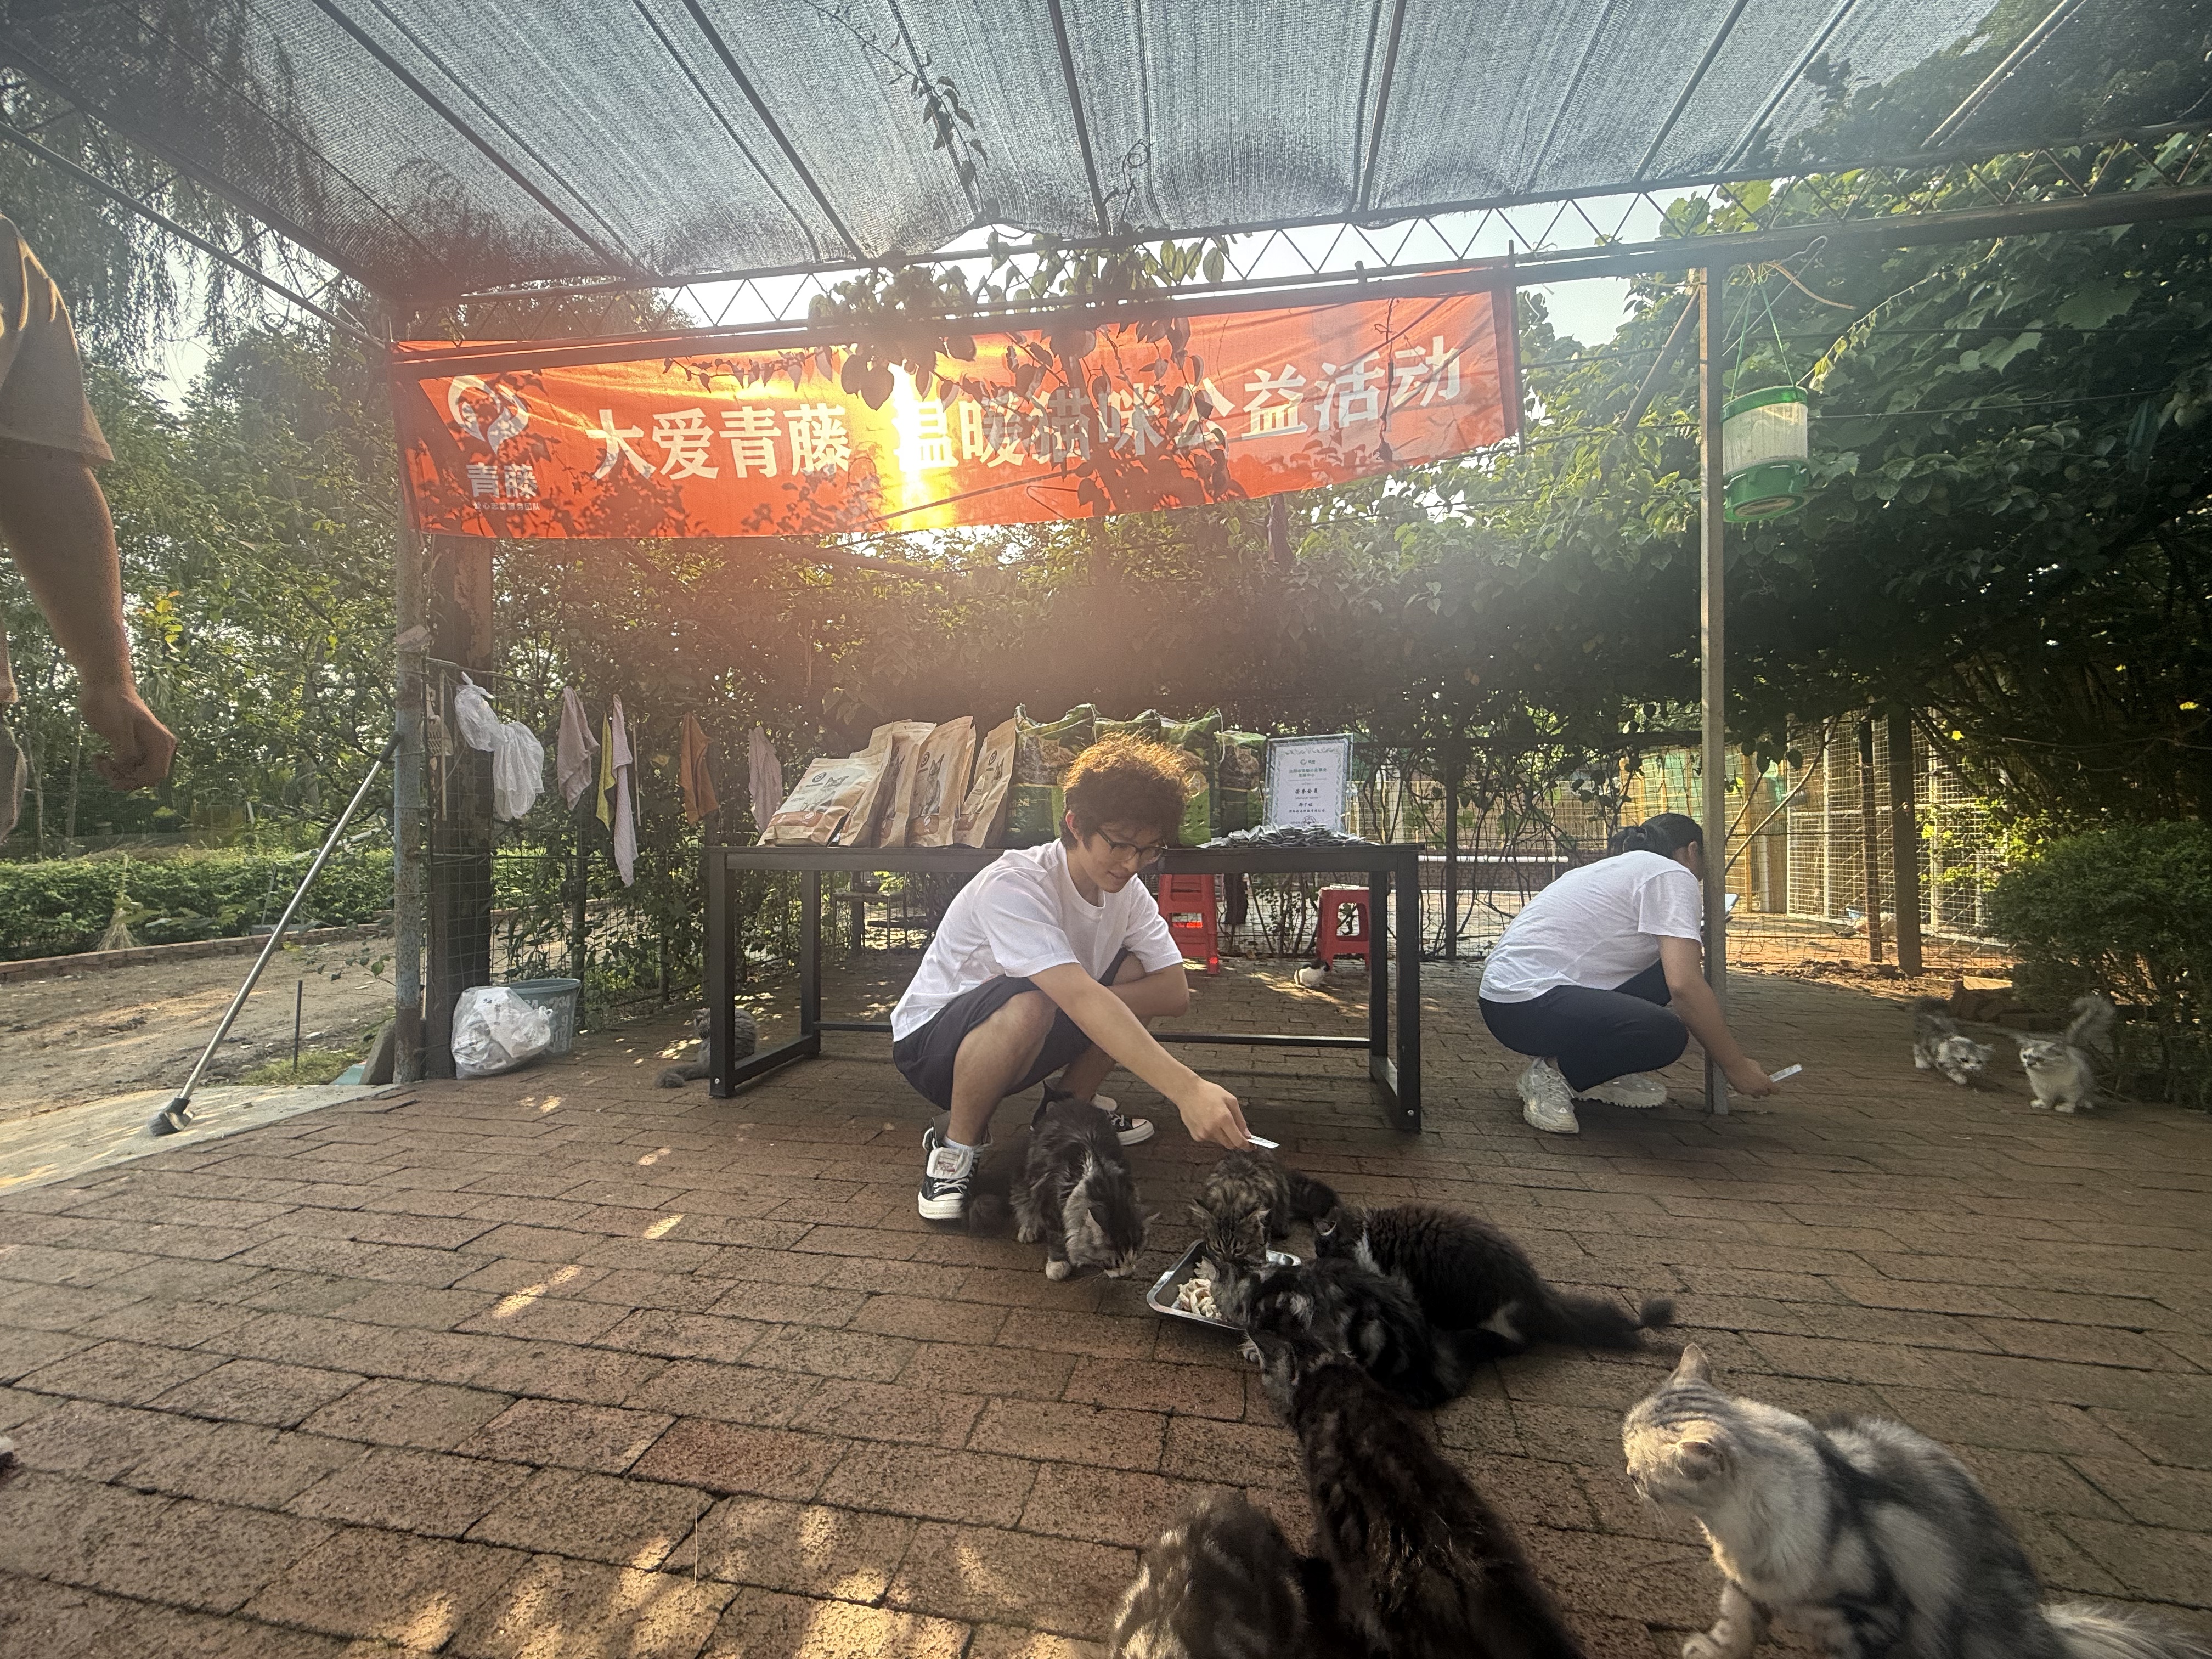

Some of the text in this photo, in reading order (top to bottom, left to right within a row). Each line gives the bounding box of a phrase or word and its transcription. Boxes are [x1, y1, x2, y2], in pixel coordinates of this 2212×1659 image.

[586, 335, 1460, 480] 大爱青藤 温暖猫咪公益活动
[466, 462, 538, 499] 青藤
